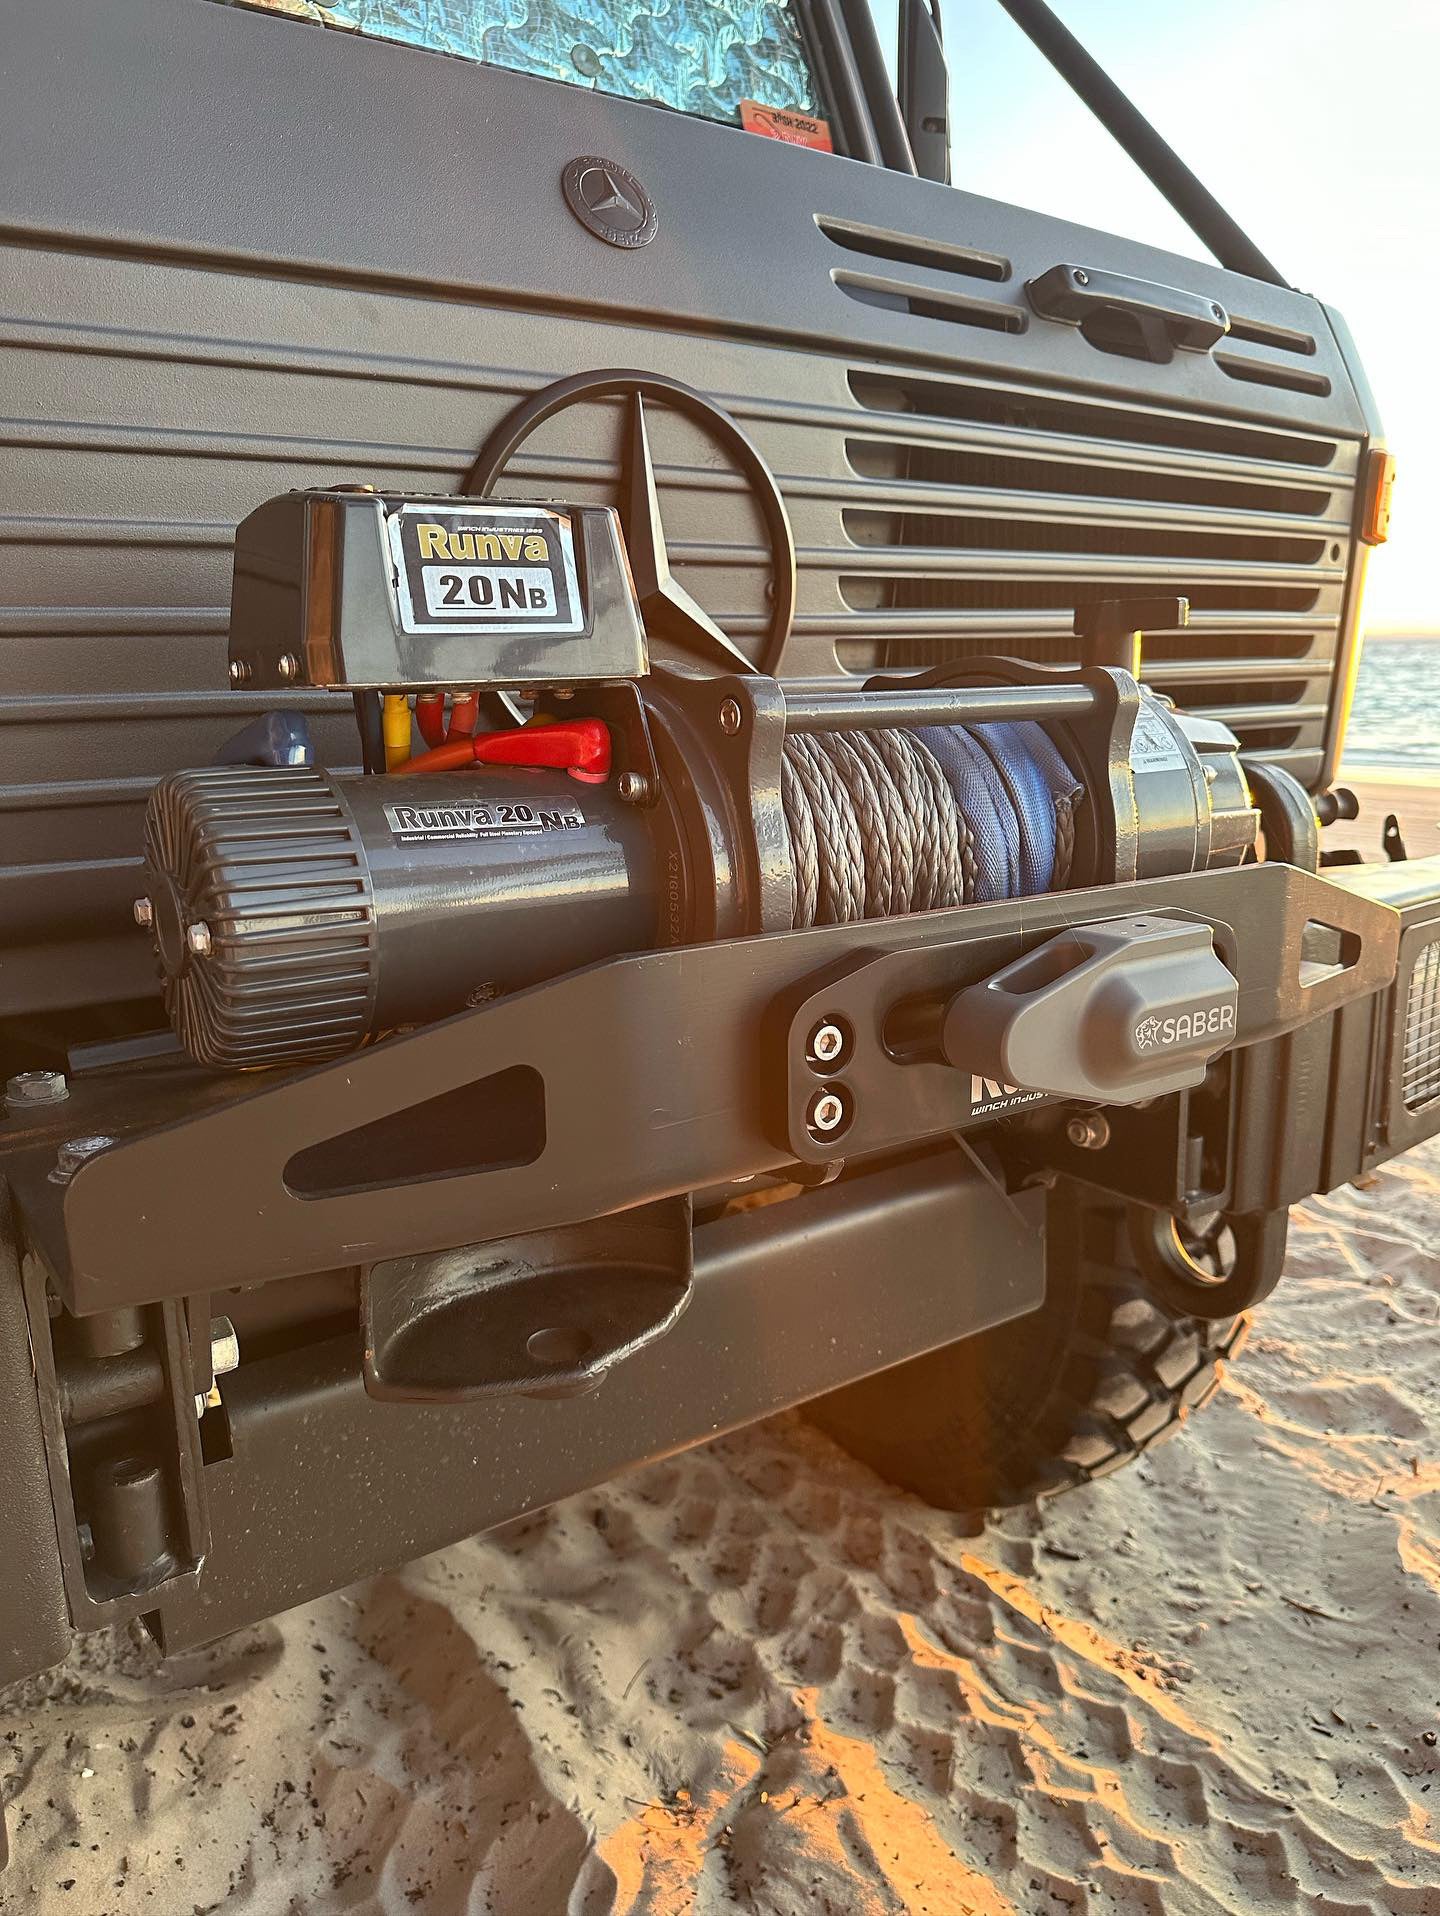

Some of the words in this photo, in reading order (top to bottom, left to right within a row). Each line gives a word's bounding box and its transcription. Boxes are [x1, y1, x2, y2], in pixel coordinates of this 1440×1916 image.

[416, 523, 549, 561] Runva
[392, 806, 494, 831] Runva
[401, 834, 425, 842] Industrial
[1161, 1005, 1234, 1044] SABER
[971, 1099, 1009, 1116] WINCH
[1010, 1091, 1049, 1106] INDUS
